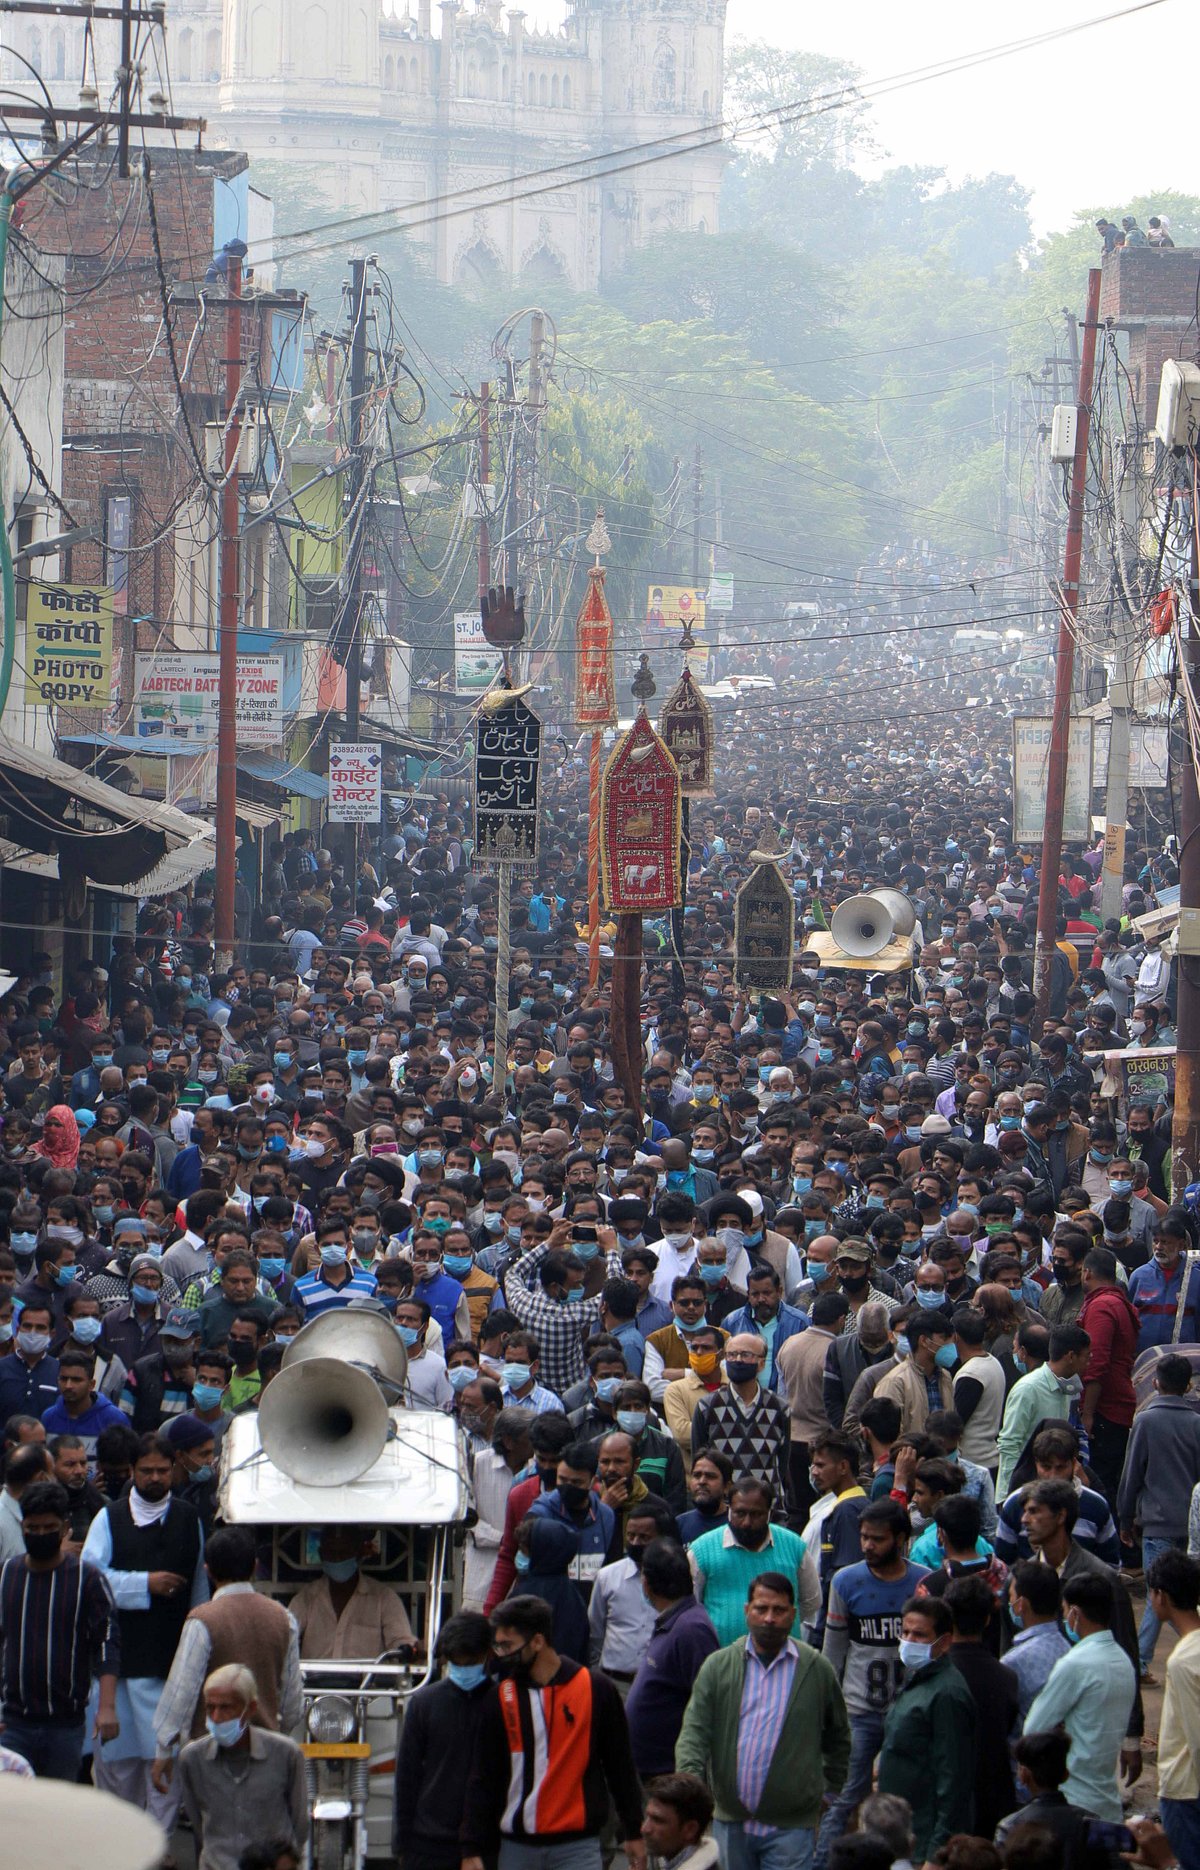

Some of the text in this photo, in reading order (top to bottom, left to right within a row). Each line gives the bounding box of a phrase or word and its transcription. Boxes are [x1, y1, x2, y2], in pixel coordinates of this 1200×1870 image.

[34, 619, 105, 644] कॉपी
[456, 622, 469, 633] ST.
[34, 659, 103, 680] PHOTO
[41, 682, 95, 702] COPY
[141, 677, 279, 694] LABTECH BATTY ZONE
[267, 698, 278, 709] की
[266, 711, 273, 722] है
[332, 746, 377, 754] 9389248706
[331, 785, 377, 802] सेन्टर
[1126, 1057, 1170, 1074] लखनऊ
[859, 1617, 903, 1640] HILFIG
